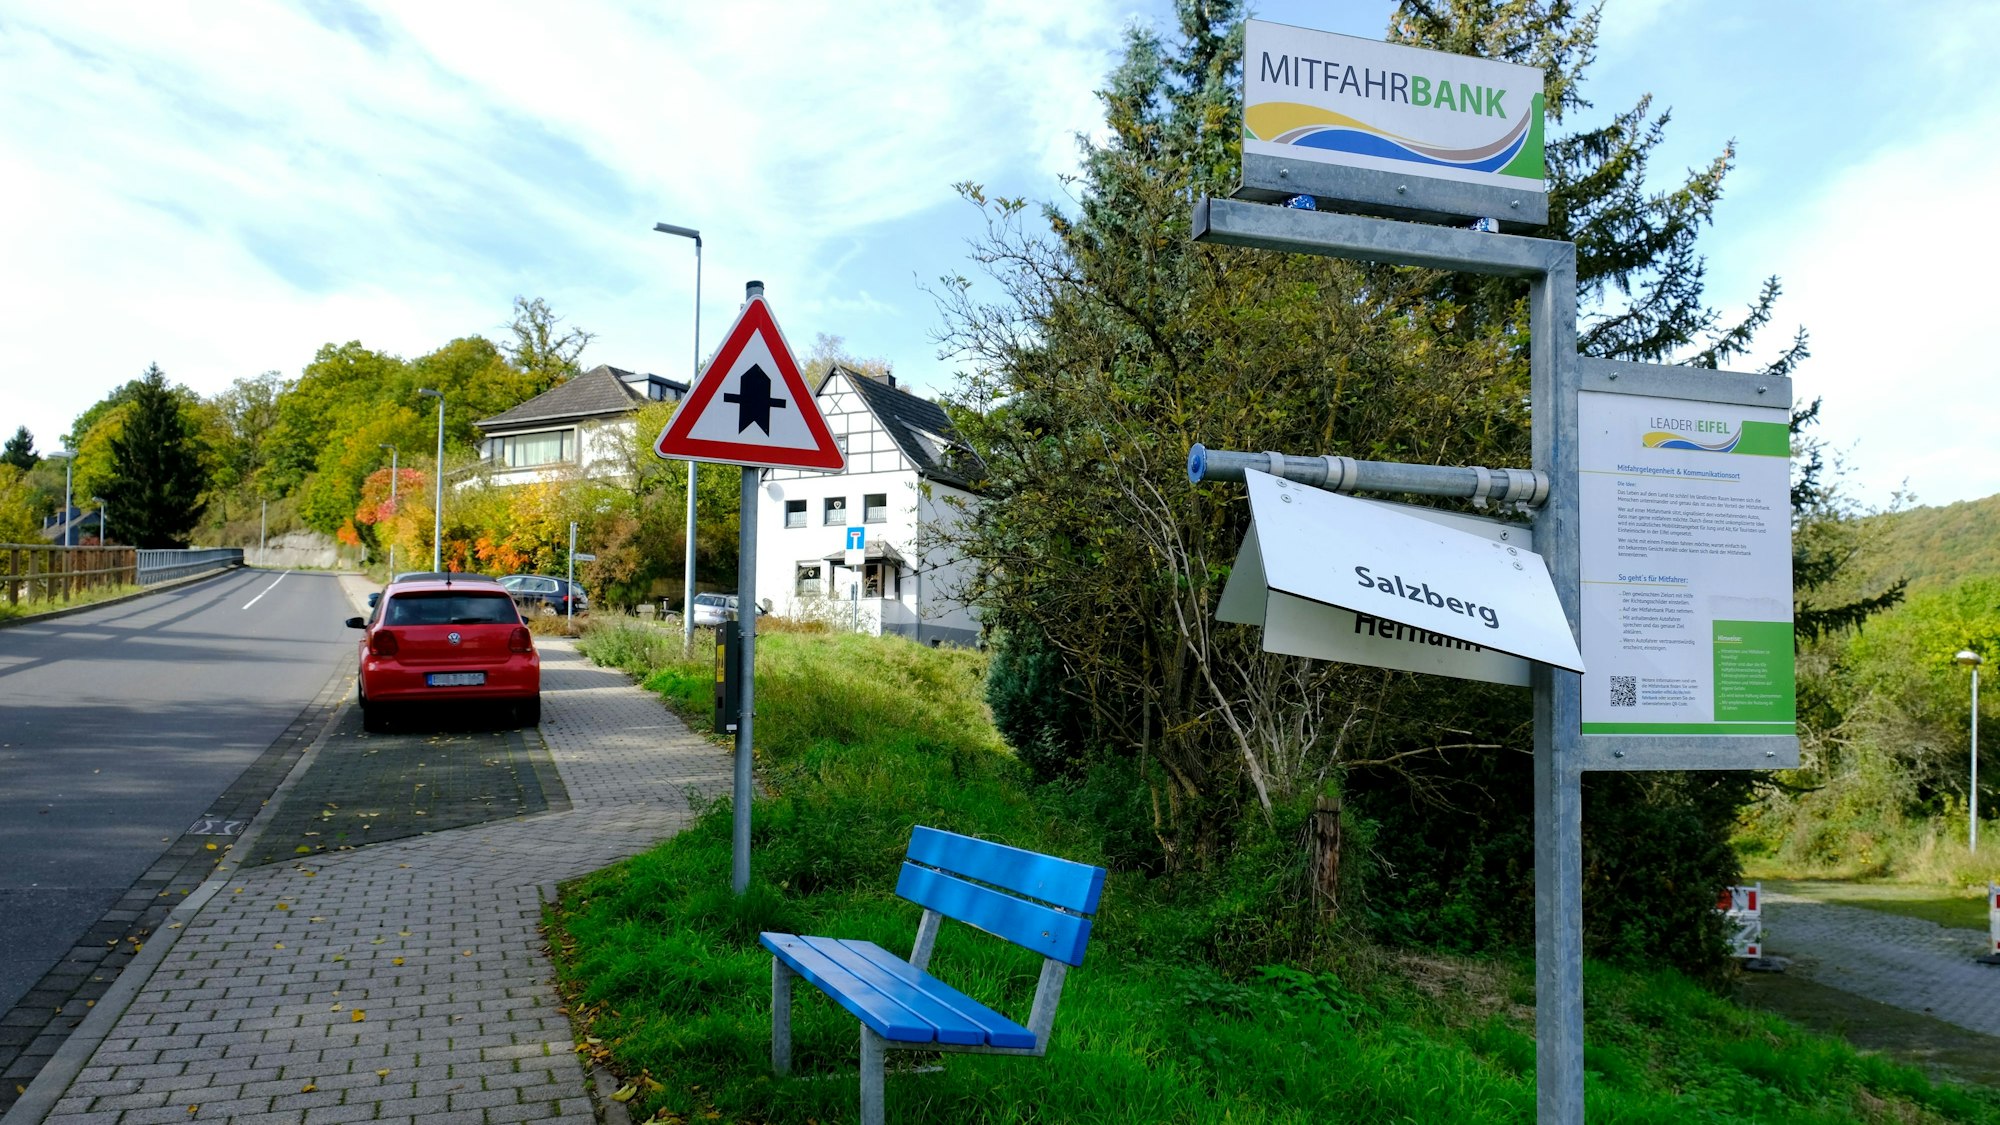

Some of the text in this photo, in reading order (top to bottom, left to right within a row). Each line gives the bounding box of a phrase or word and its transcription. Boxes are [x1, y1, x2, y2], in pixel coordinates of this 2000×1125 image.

[1260, 51, 1507, 119] MITFAHRBANK
[1650, 417, 1692, 432] LEADER
[1698, 420, 1730, 434] EIFEL
[1618, 464, 1675, 476] Mitfahrgelegenheit
[1684, 468, 1740, 479] Kommunikationsort
[1658, 576, 1689, 584] Mitfahrer:
[1354, 566, 1500, 629] Salzberg
